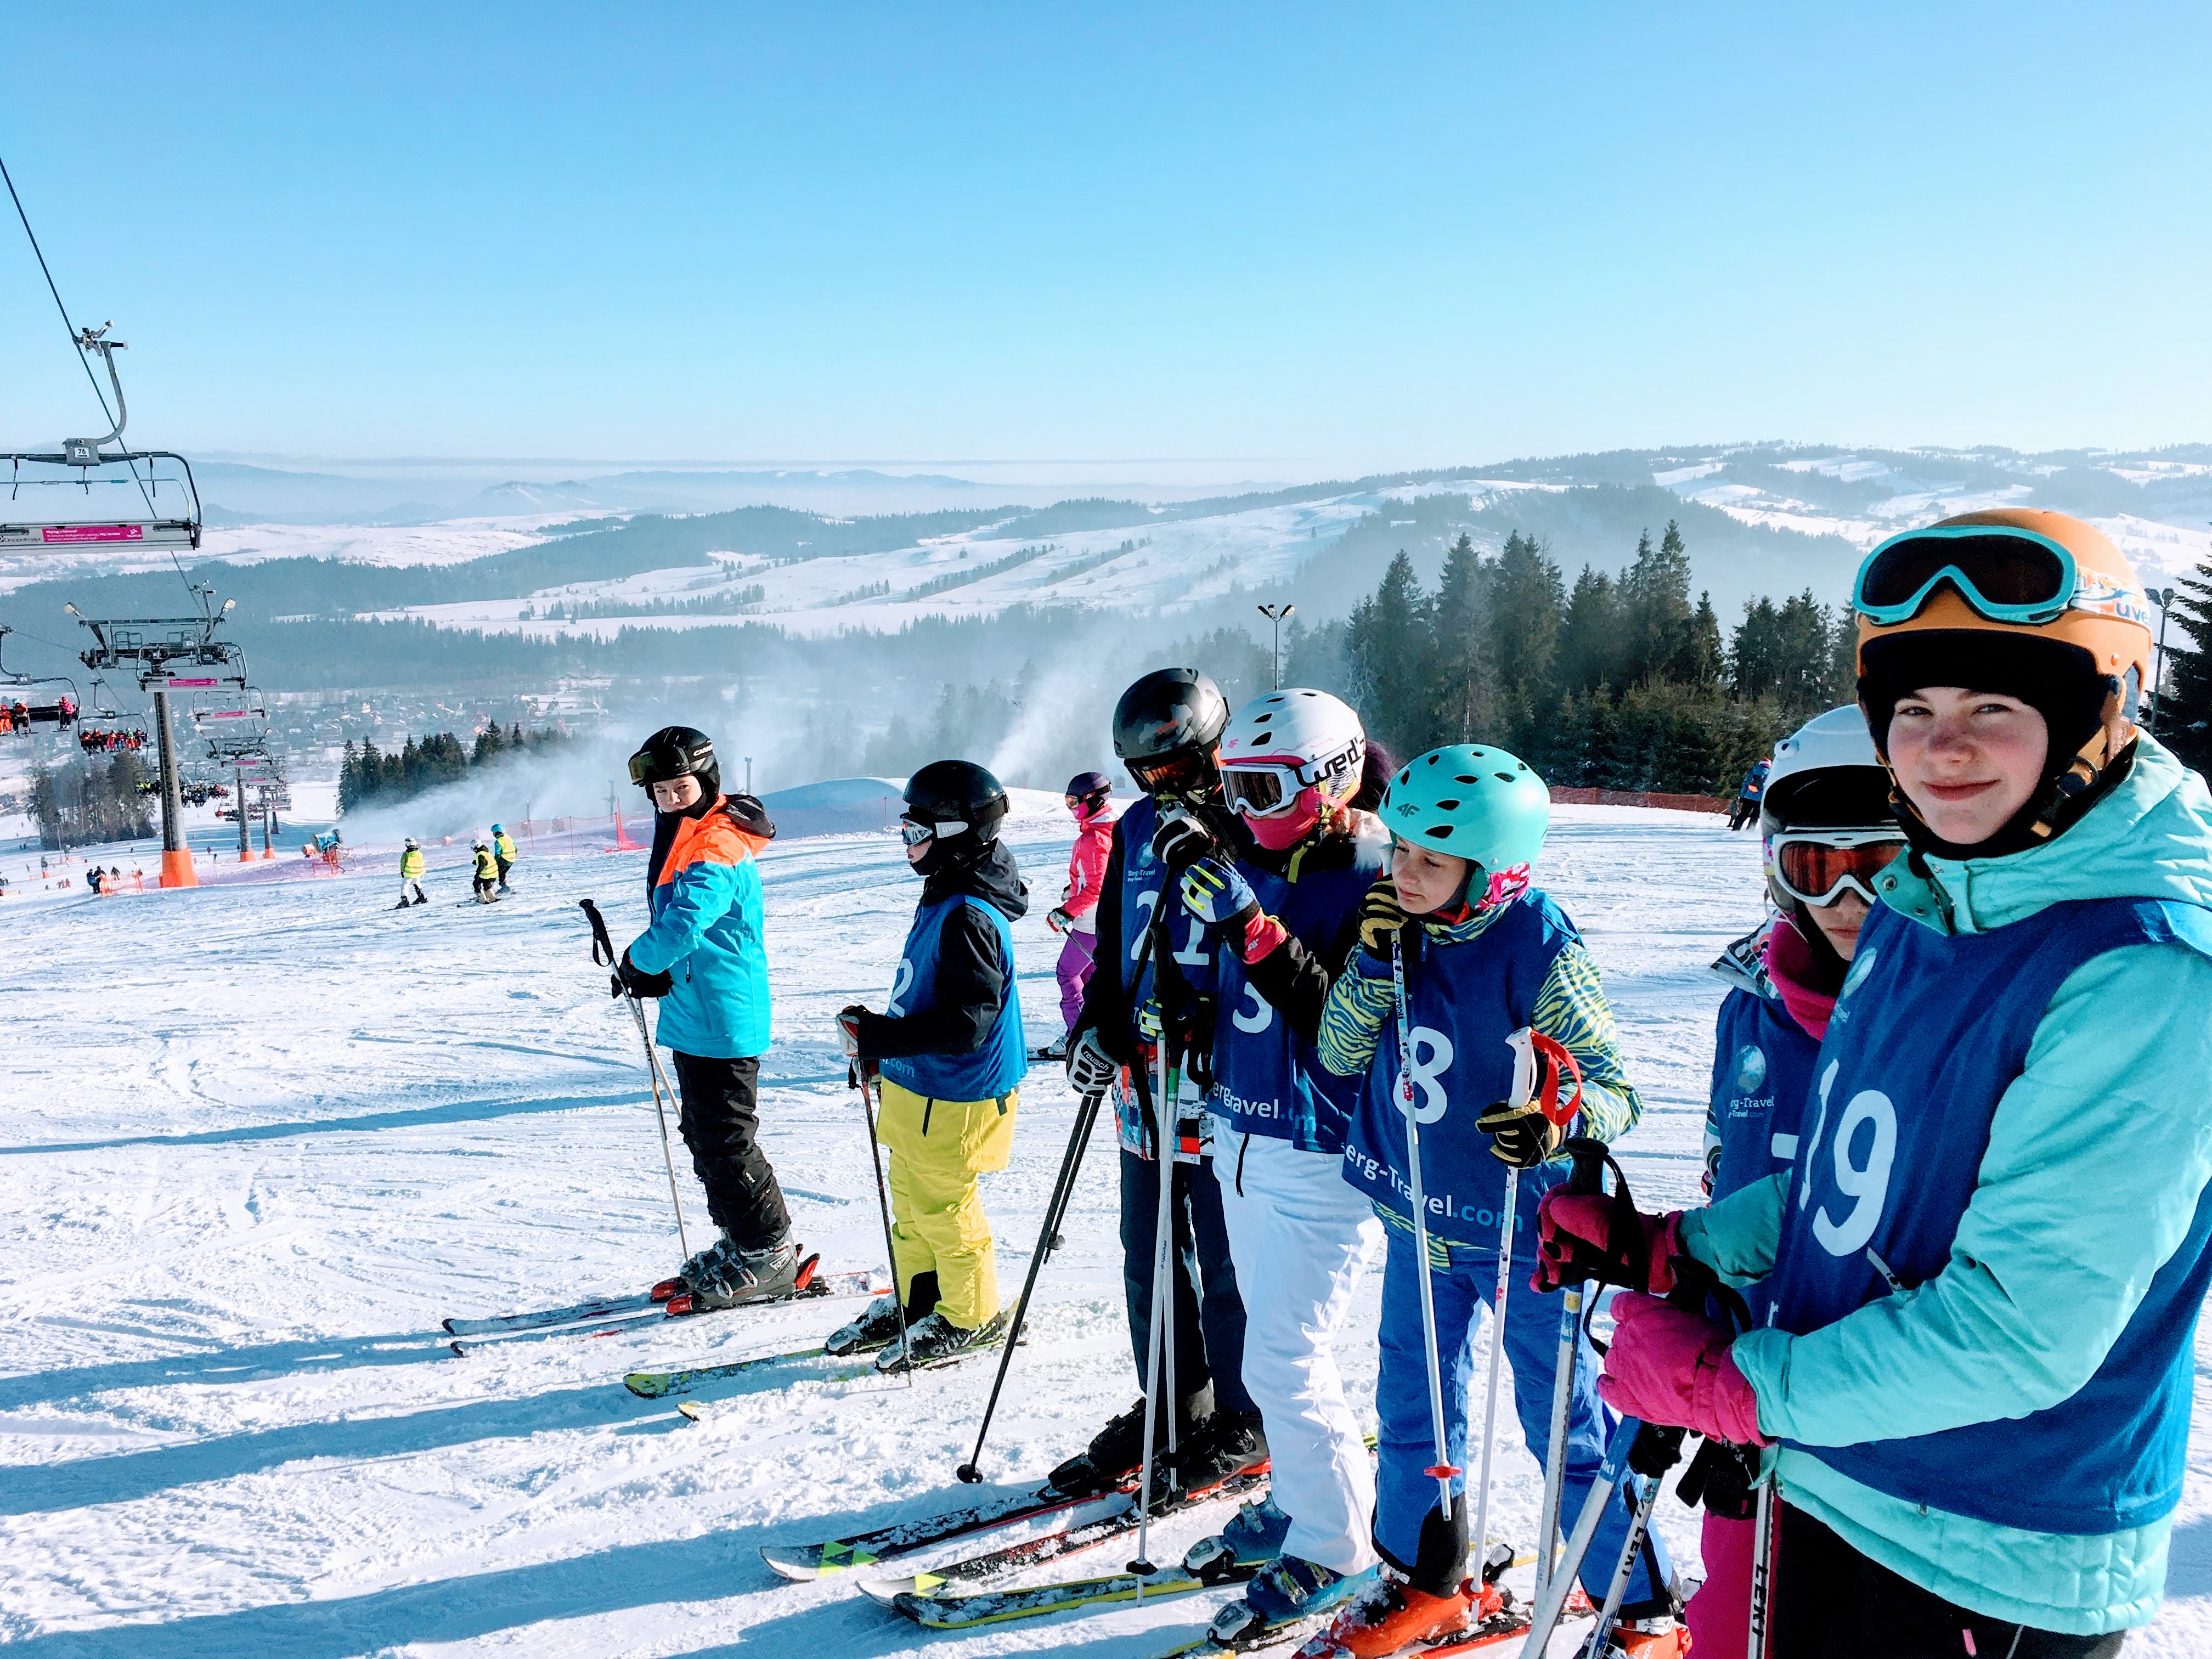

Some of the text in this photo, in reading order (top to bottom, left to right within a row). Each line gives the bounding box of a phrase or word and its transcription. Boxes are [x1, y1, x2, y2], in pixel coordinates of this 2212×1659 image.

[2116, 602, 2151, 627] uve
[1396, 803, 1421, 817] 4F
[1131, 889, 1210, 966] 21
[889, 958, 914, 1018] 2
[1083, 1051, 1109, 1071] reusch
[1393, 1026, 1454, 1125] 8
[1729, 1095, 1774, 1109] rg-Travel
[1345, 1143, 1523, 1232] erg-Trael.com
[1799, 1058, 1898, 1257] 19
[1622, 1526, 1645, 1577] LEKI
[1752, 1563, 1768, 1638] LEKI
